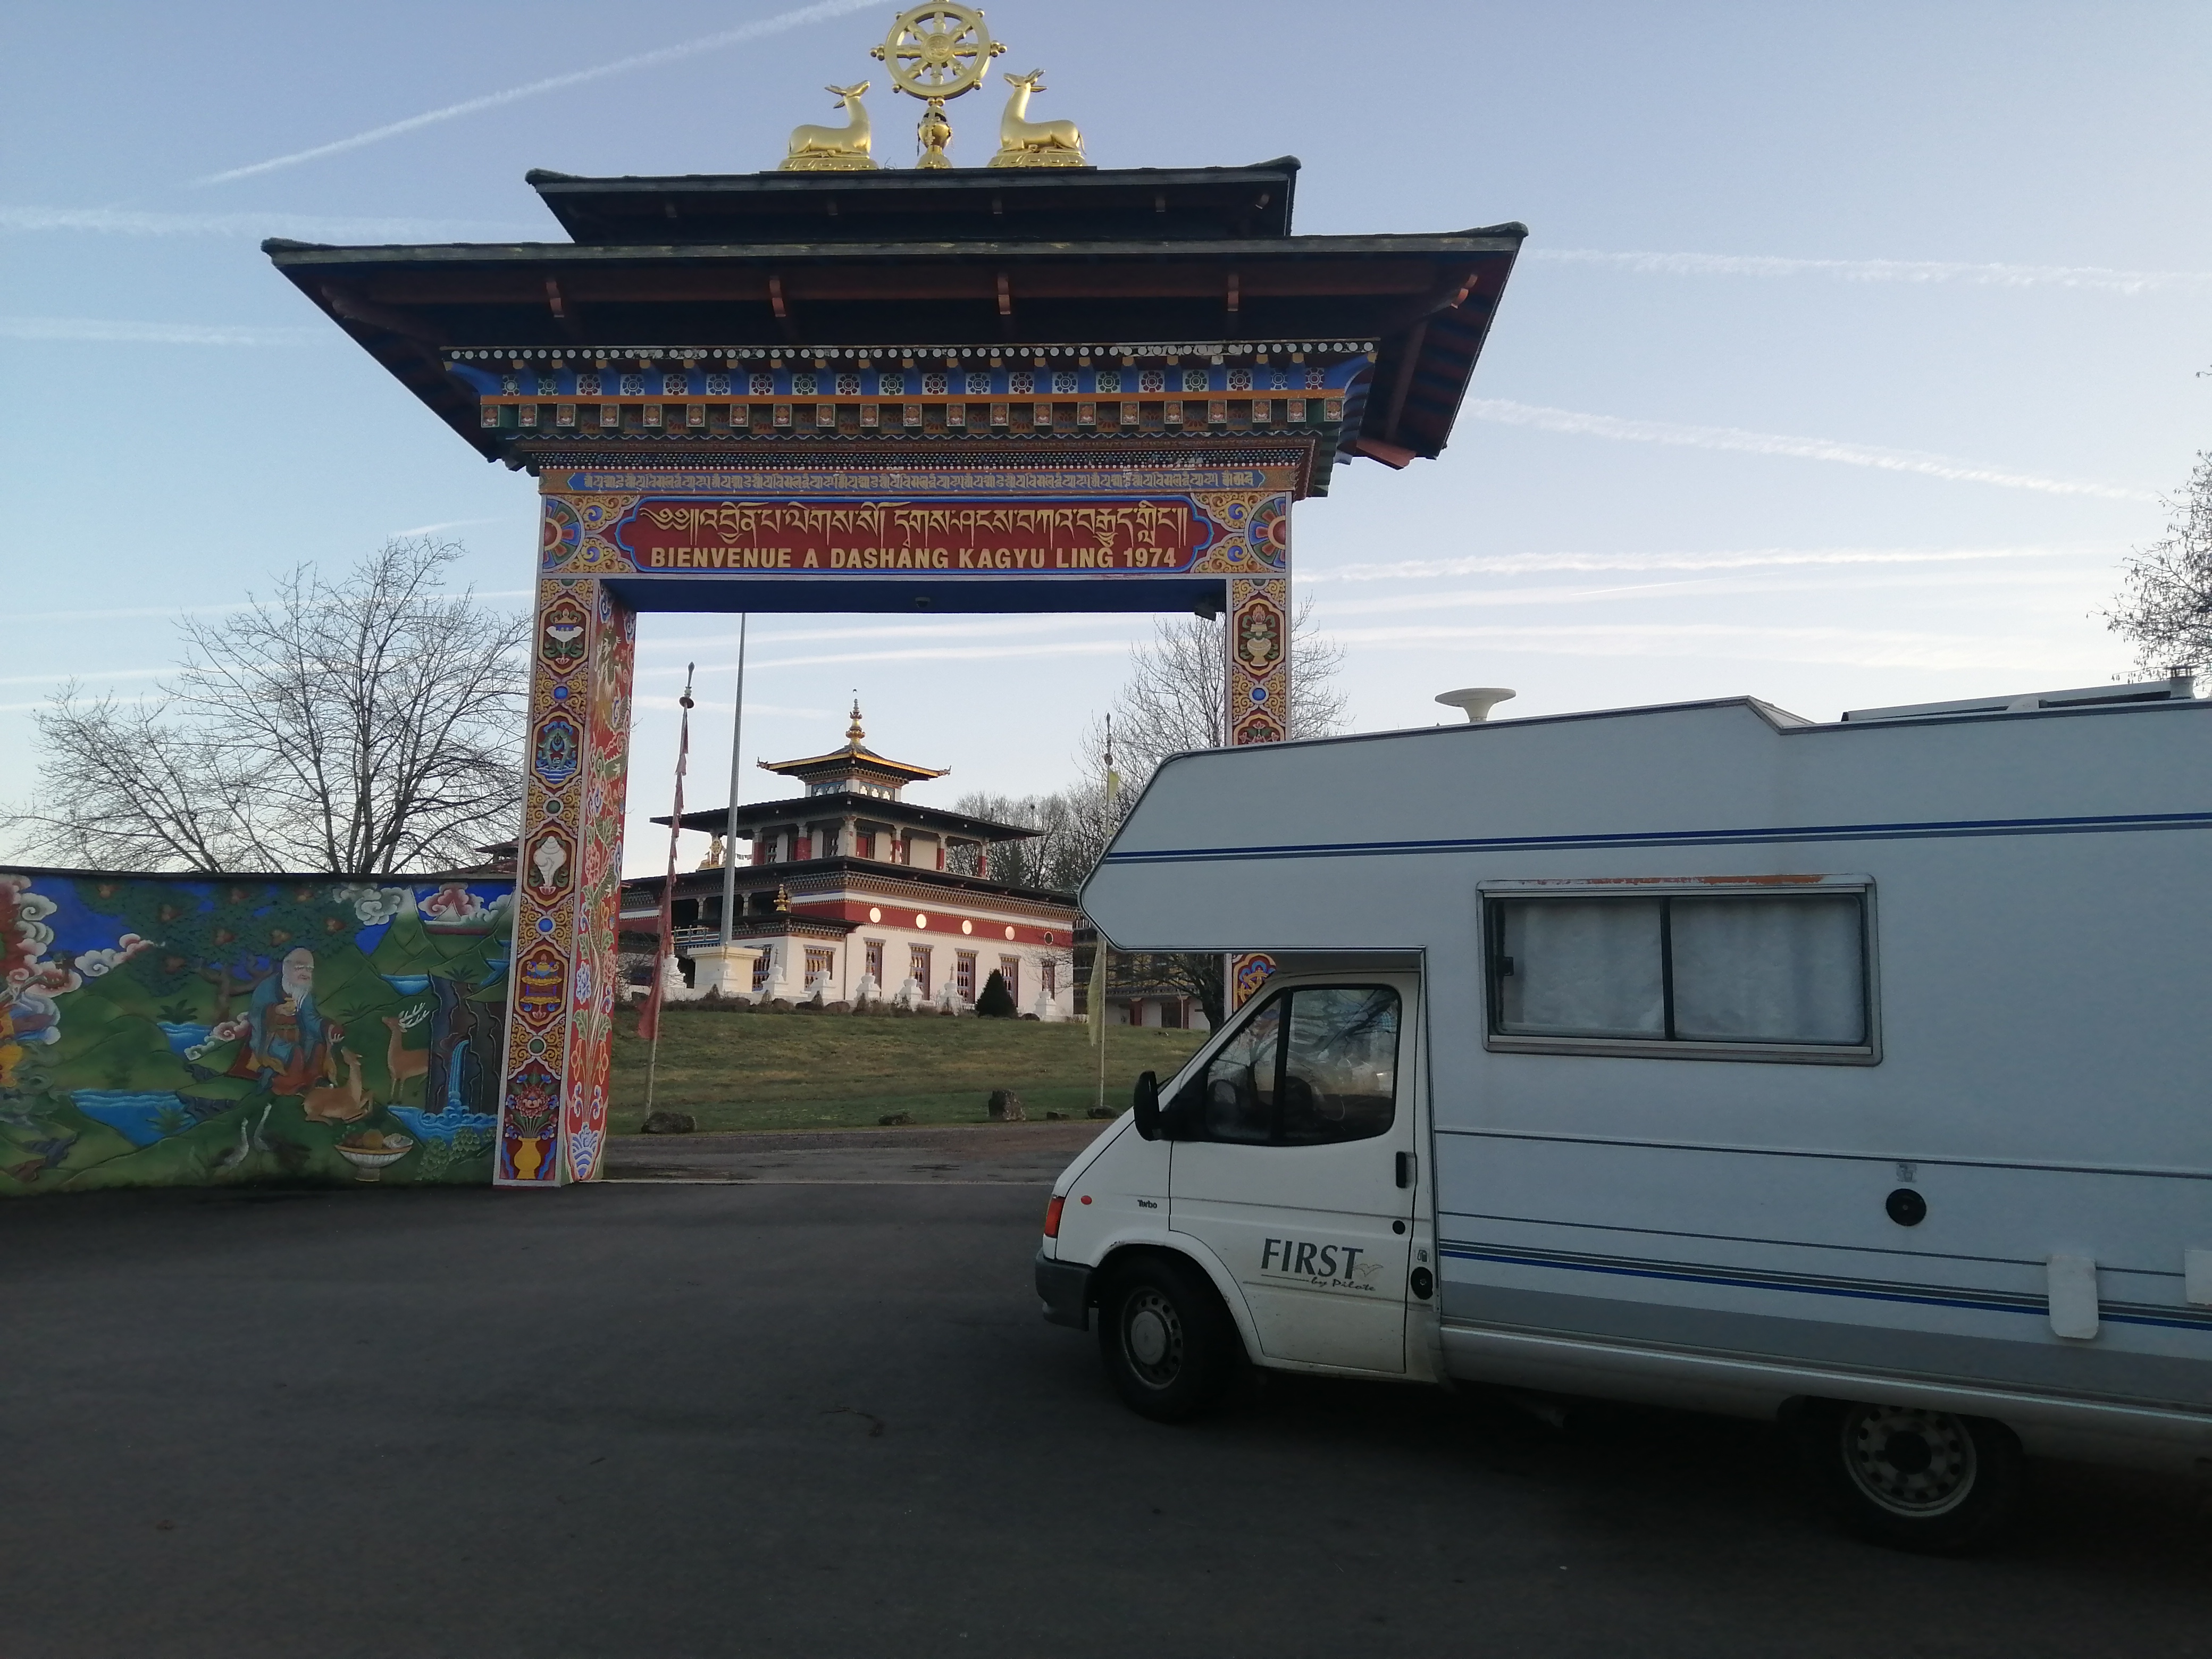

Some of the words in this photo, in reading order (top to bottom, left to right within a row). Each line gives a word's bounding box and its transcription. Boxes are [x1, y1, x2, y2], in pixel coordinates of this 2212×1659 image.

[651, 547, 791, 568] BIENVENUE
[803, 548, 819, 568] A
[831, 547, 949, 568] DASHANG
[959, 547, 1045, 568] KAGYU
[1056, 547, 1114, 568] LING
[1123, 547, 1176, 567] 1974
[1137, 1199, 1158, 1209] Turbo
[1261, 1238, 1364, 1279] FIRST
[1309, 1277, 1327, 1287] by
[1333, 1278, 1376, 1292] Pilote
